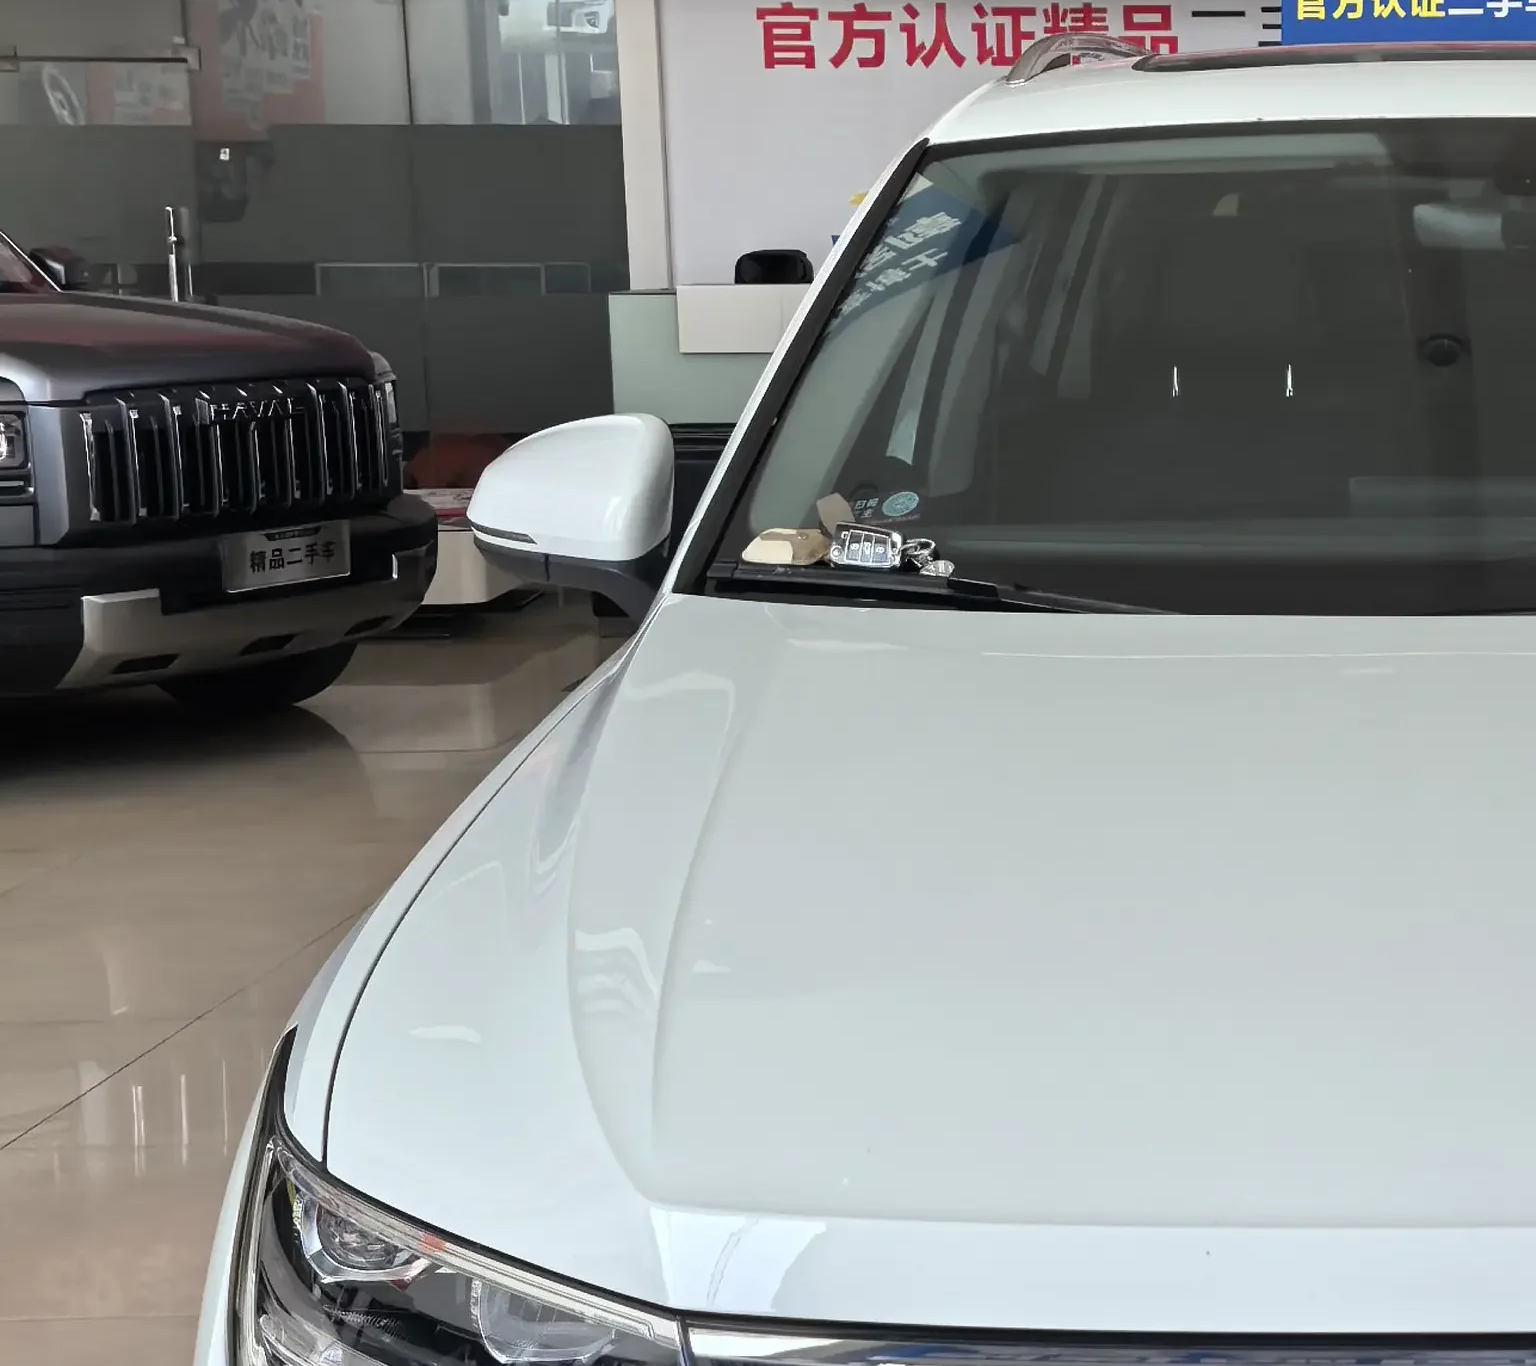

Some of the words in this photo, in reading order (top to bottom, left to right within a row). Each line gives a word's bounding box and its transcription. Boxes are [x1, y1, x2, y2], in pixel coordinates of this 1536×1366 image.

[755, 1, 1282, 70] 官方认证精品
[250, 541, 337, 574] 精品二手车
